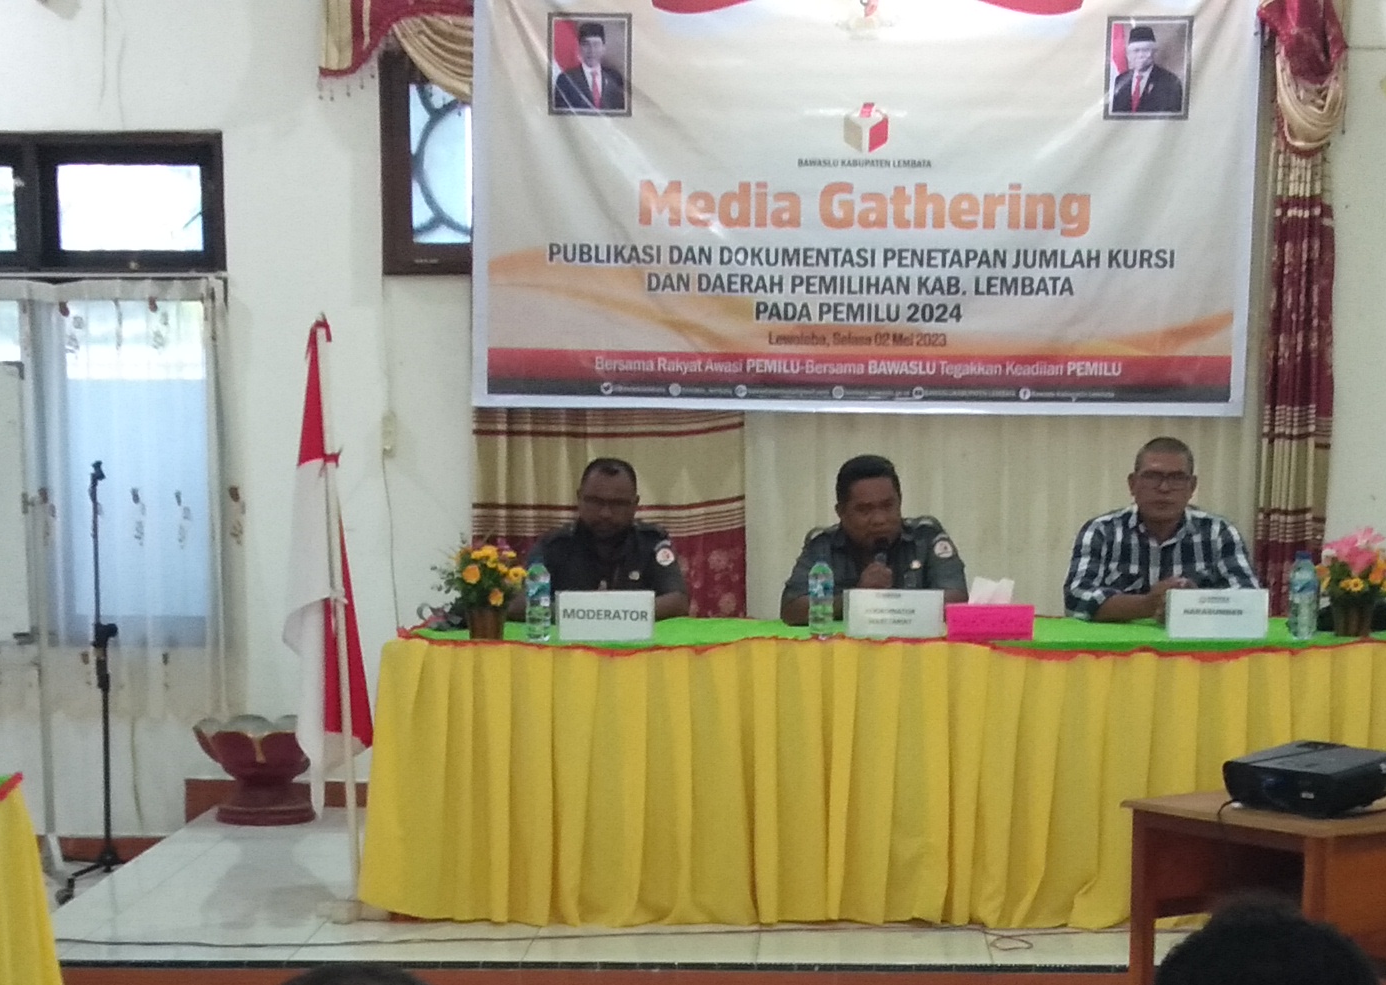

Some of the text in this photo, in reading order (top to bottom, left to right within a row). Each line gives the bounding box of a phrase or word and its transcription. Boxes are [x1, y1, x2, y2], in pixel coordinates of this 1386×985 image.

[797, 158, 839, 168] BAWASLU
[841, 159, 891, 168] KABUPATEN
[638, 179, 1091, 238] Media Gathering
[548, 243, 1175, 269] PUBLIKASI DAN DOKUMENTASI PENETAPAN JUMLAH KURSI
[647, 273, 1074, 297] DAN DAERAH PEMILIHAN KAB. LEMBATA
[755, 301, 962, 323] PADA PEMILU 2024
[874, 333, 891, 346] 02
[916, 333, 947, 347] 2023
[595, 356, 653, 371] Bersama
[657, 357, 702, 375] Rakyat
[705, 358, 743, 373] Awasi
[868, 360, 935, 375] BAWASLU
[939, 361, 1002, 378] Tegakkan
[1006, 361, 1063, 376] Keadilan
[1067, 361, 1122, 376] PEMILU
[562, 608, 648, 621] MODERATOR
